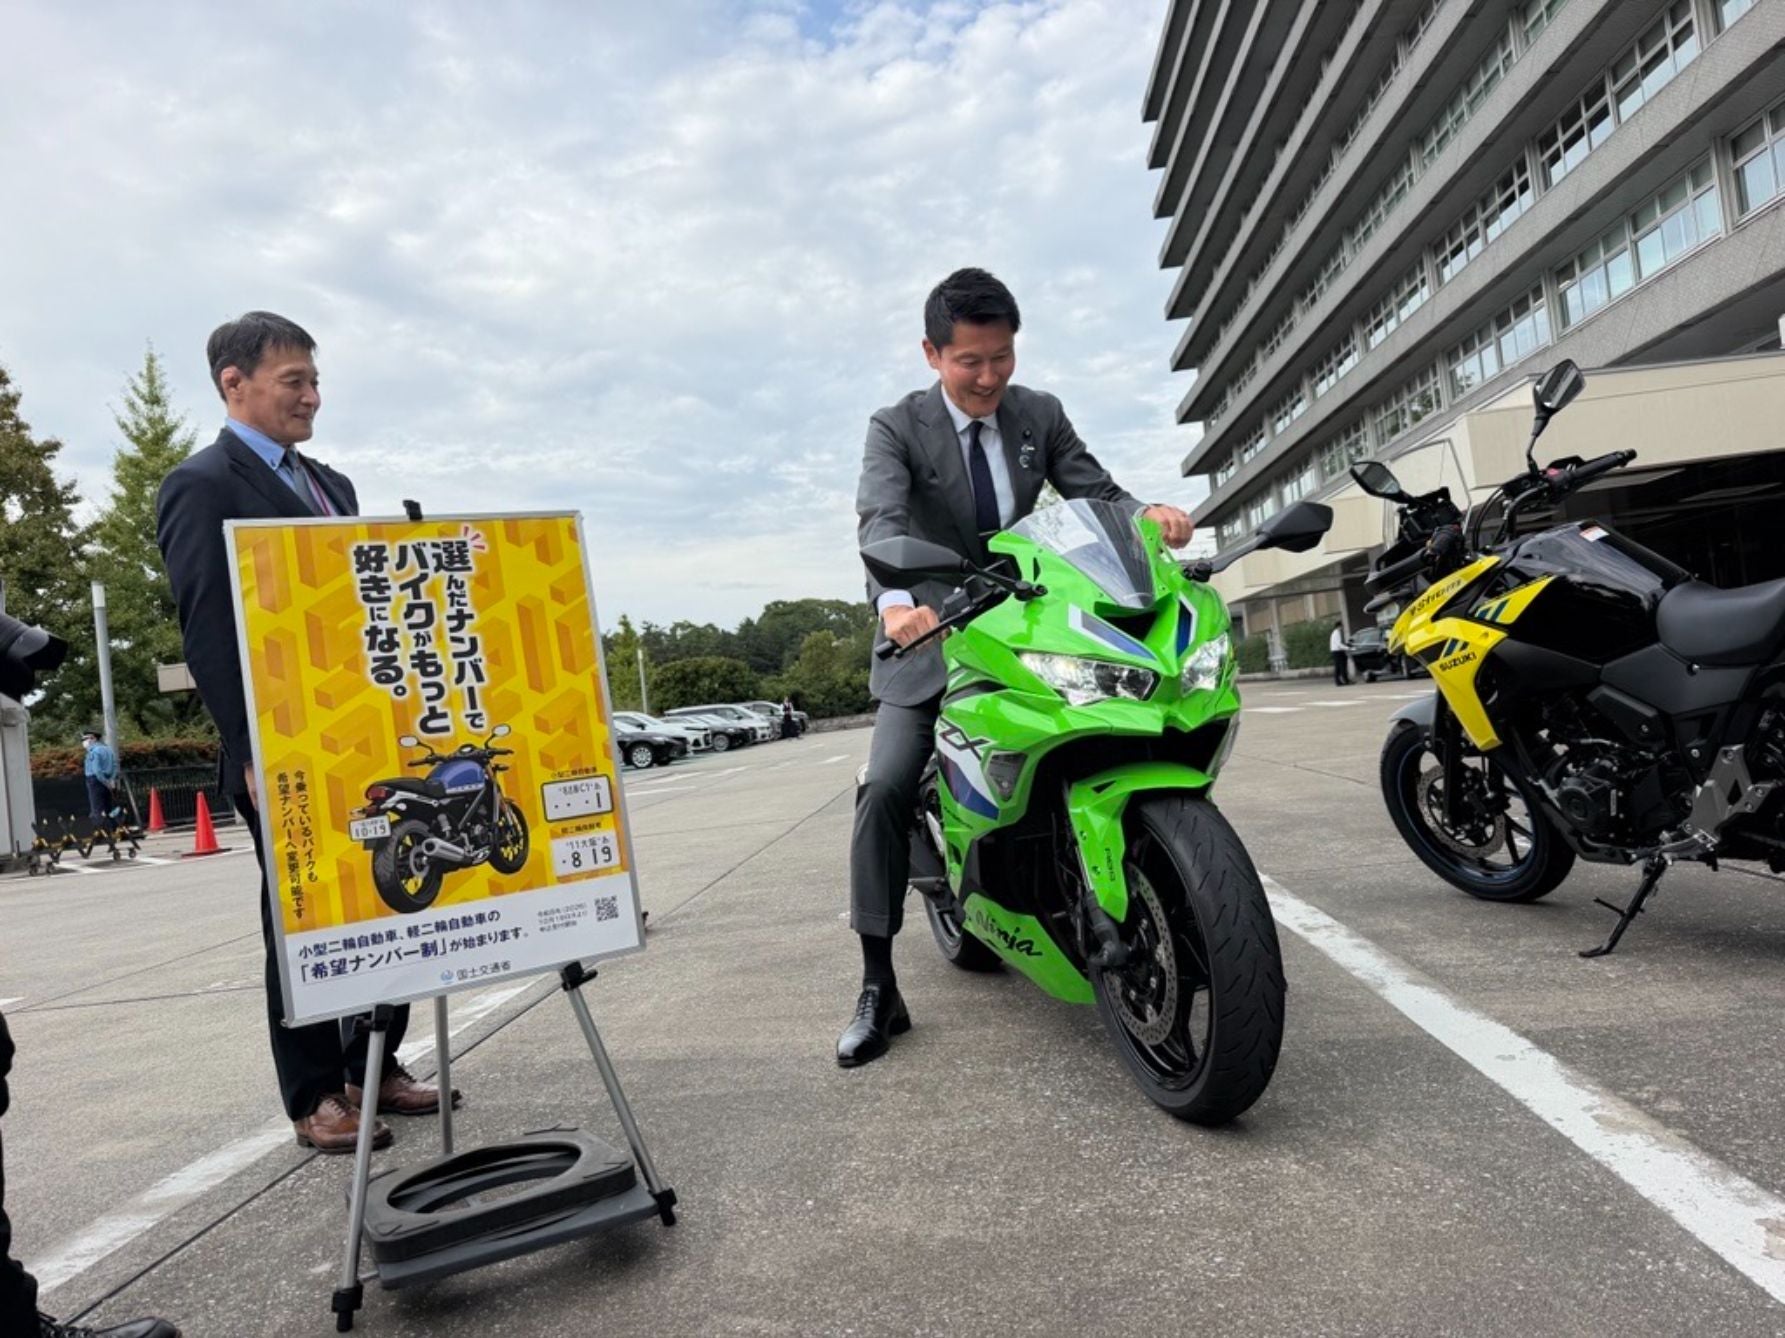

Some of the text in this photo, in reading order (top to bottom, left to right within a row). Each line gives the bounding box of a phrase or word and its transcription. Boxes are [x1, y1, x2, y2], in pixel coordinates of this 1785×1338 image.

[354, 545, 407, 696] 好きになる。
[396, 542, 450, 734] バイクがもっと
[431, 540, 485, 728] 選んだナンバーで
[1439, 652, 1477, 671] SUZUKI
[277, 772, 305, 919] 希望ナンバーへ変更可能です
[294, 770, 318, 882] 今乗っているバイクも
[299, 910, 501, 959] 小型二輪自動車、軽二輪自動車の
[456, 960, 512, 981] 国土交通省
[975, 909, 1043, 956] Ninja
